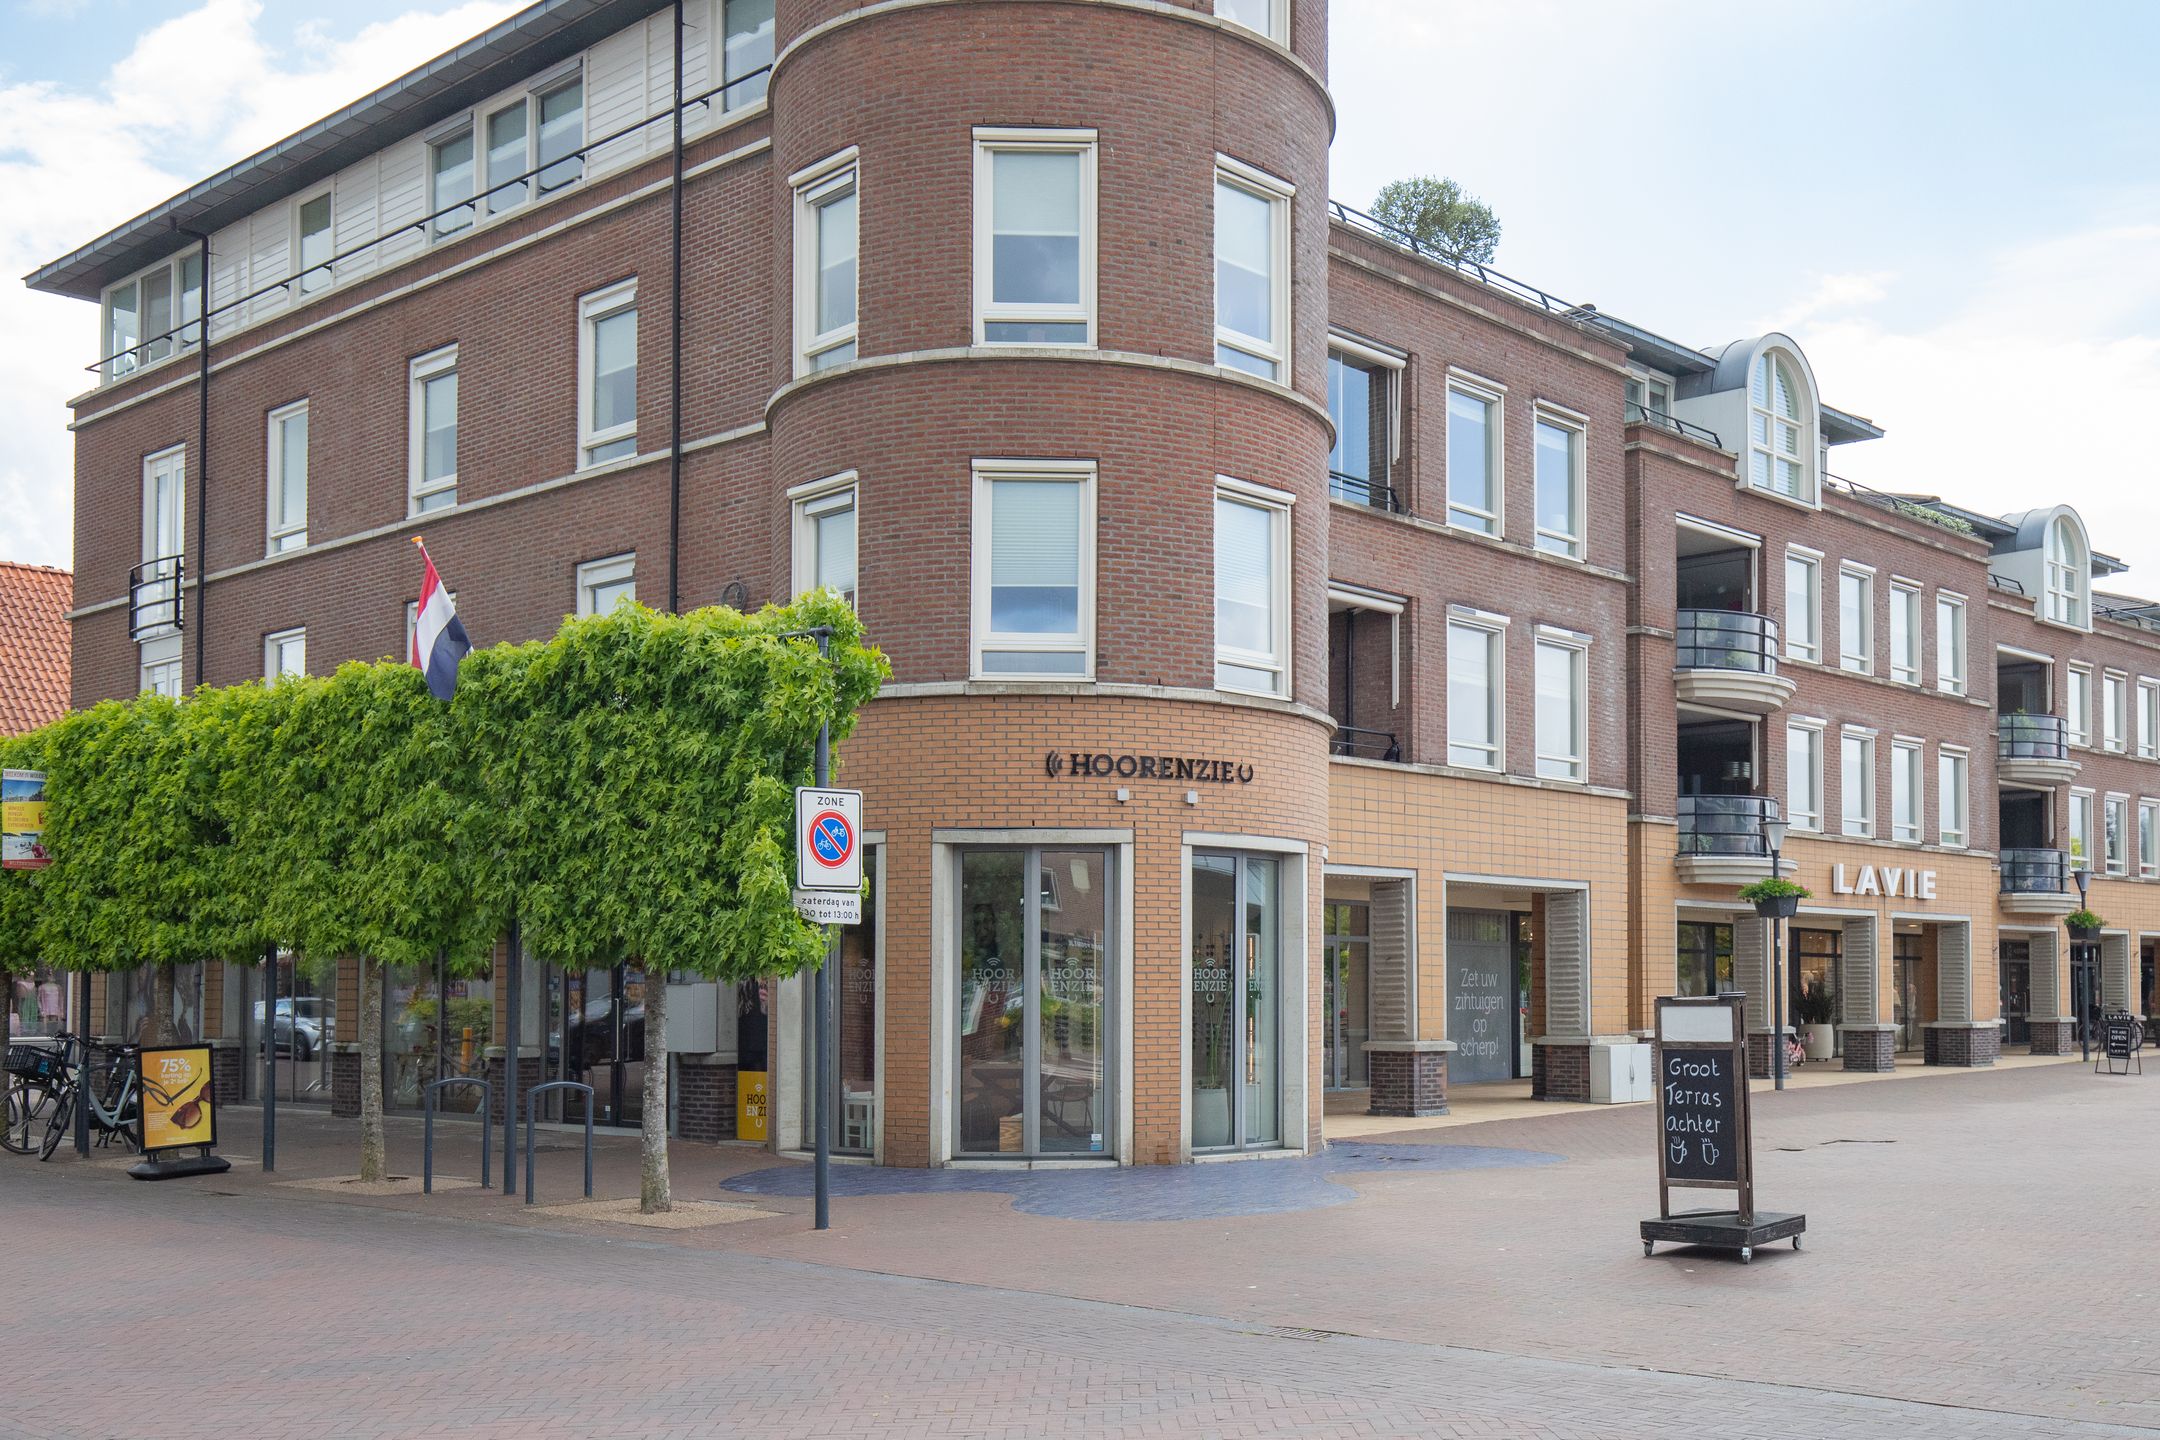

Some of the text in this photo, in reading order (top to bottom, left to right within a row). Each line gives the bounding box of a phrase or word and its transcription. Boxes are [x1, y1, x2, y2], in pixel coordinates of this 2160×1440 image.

[1070, 753, 1235, 783] HOORENZIE
[817, 796, 845, 807] ZONE
[1832, 863, 1937, 900] LAVIE
[801, 897, 840, 908] zaterdag
[819, 910, 831, 918] tot
[834, 911, 853, 919] 13:00
[972, 968, 1015, 980] HOOR
[1051, 968, 1095, 980] HOOR
[1194, 968, 1227, 979] HOOR
[1460, 968, 1498, 987] Zet uw
[1051, 981, 1095, 992] ENZIE
[1194, 980, 1227, 992] ENZIE
[1455, 992, 1504, 1015] zintuigen
[1473, 1019, 1487, 1037] op
[1460, 1037, 1499, 1060] scherp!
[160, 1058, 192, 1073] 75%
[1669, 1058, 1720, 1076] Groot
[746, 1093, 766, 1104] HOO
[1665, 1082, 1721, 1107] Terras
[746, 1105, 767, 1116] ENZI
[1666, 1112, 1721, 1133] achter
